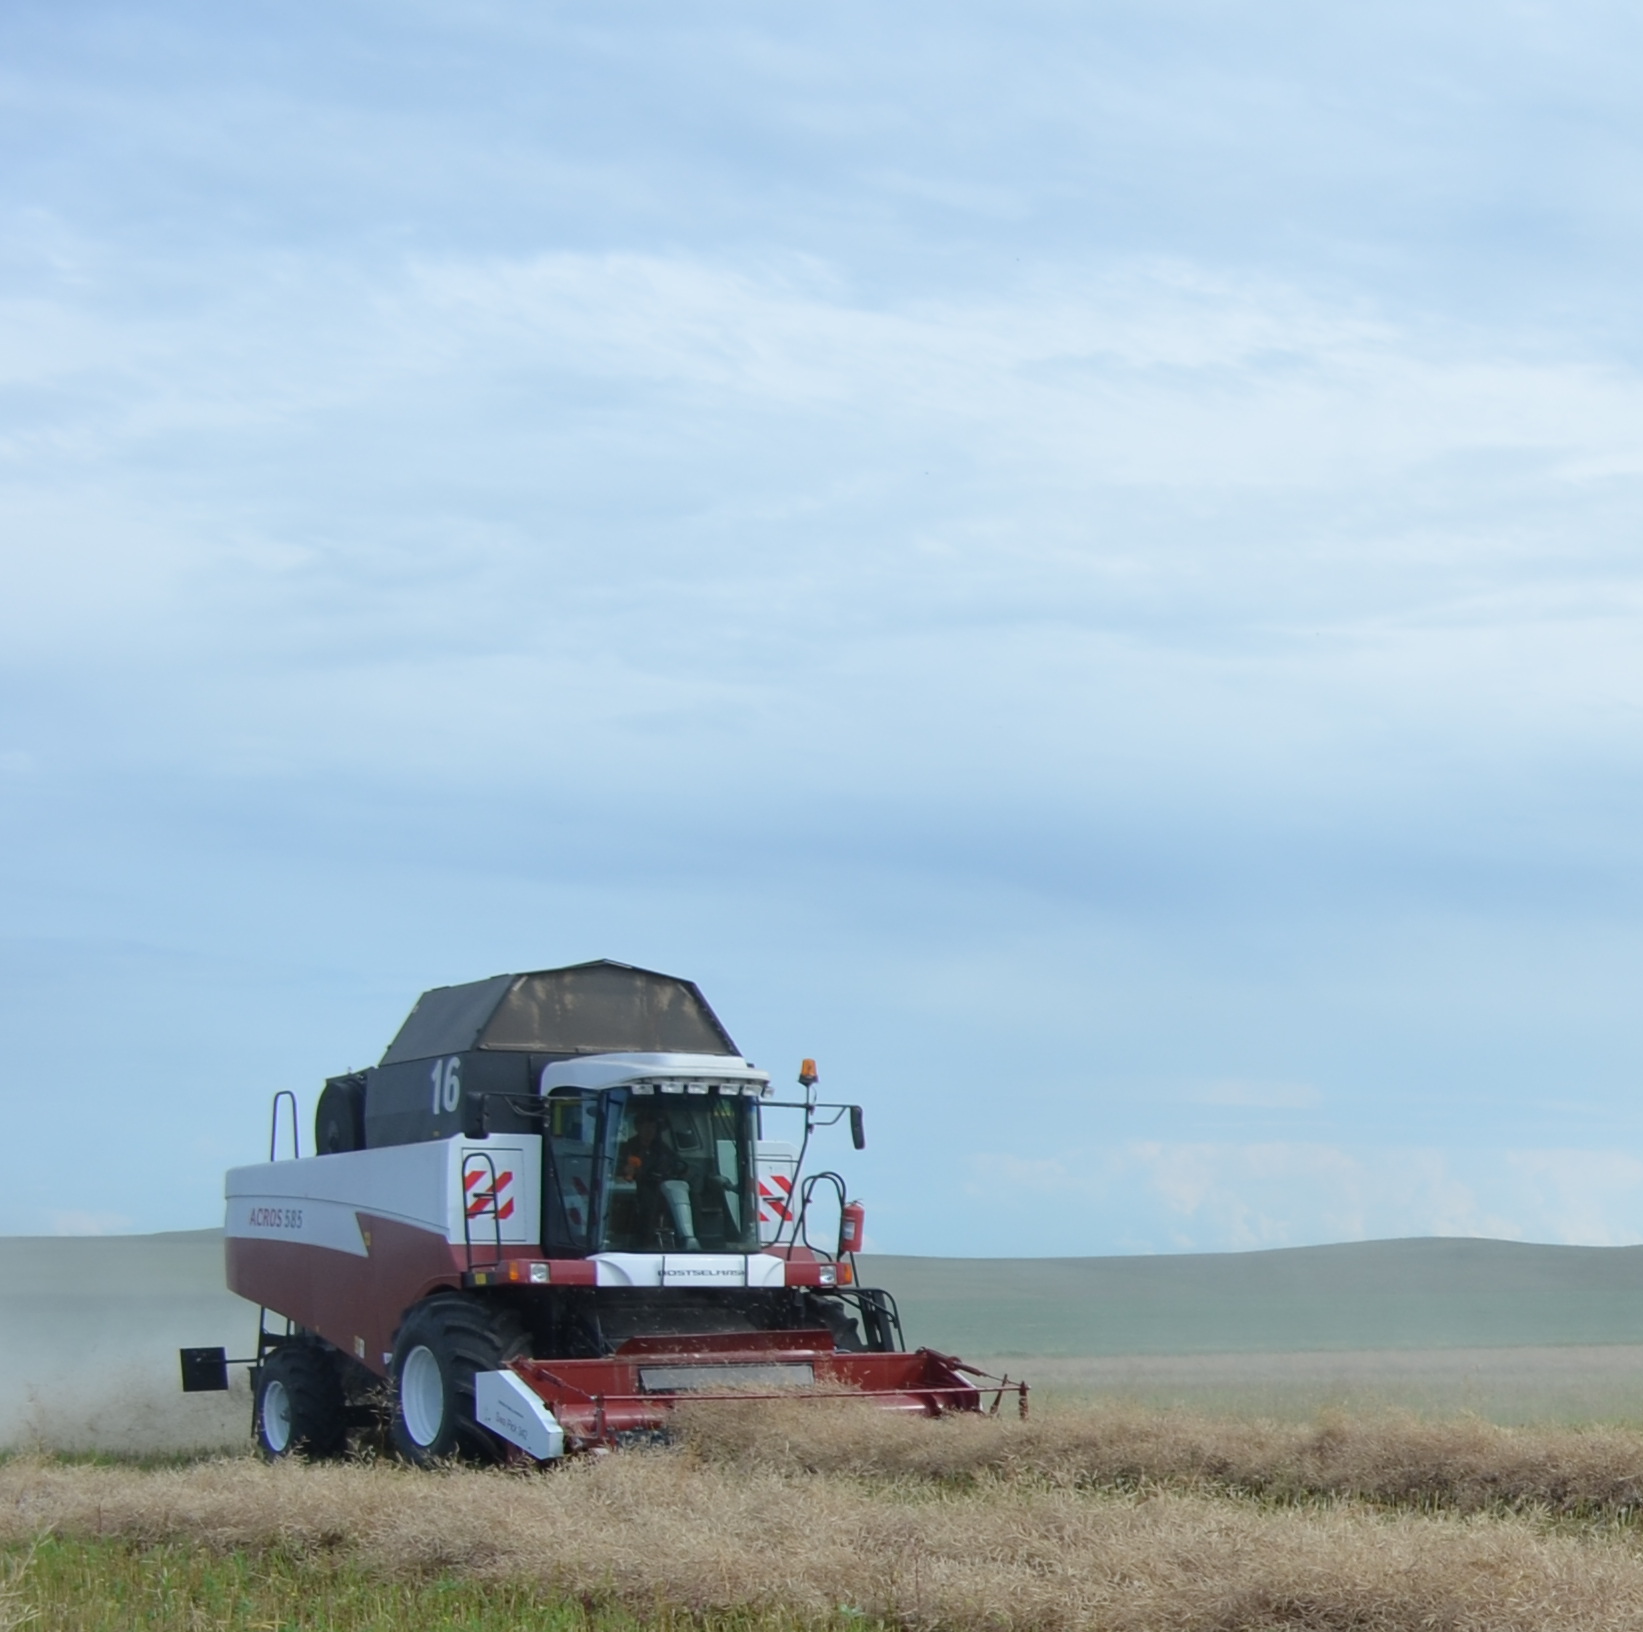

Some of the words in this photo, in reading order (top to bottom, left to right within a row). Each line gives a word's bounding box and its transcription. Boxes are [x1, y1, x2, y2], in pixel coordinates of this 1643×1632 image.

[431, 1056, 461, 1115] 16
[249, 1207, 283, 1228] ACROS
[284, 1209, 303, 1229] 585
